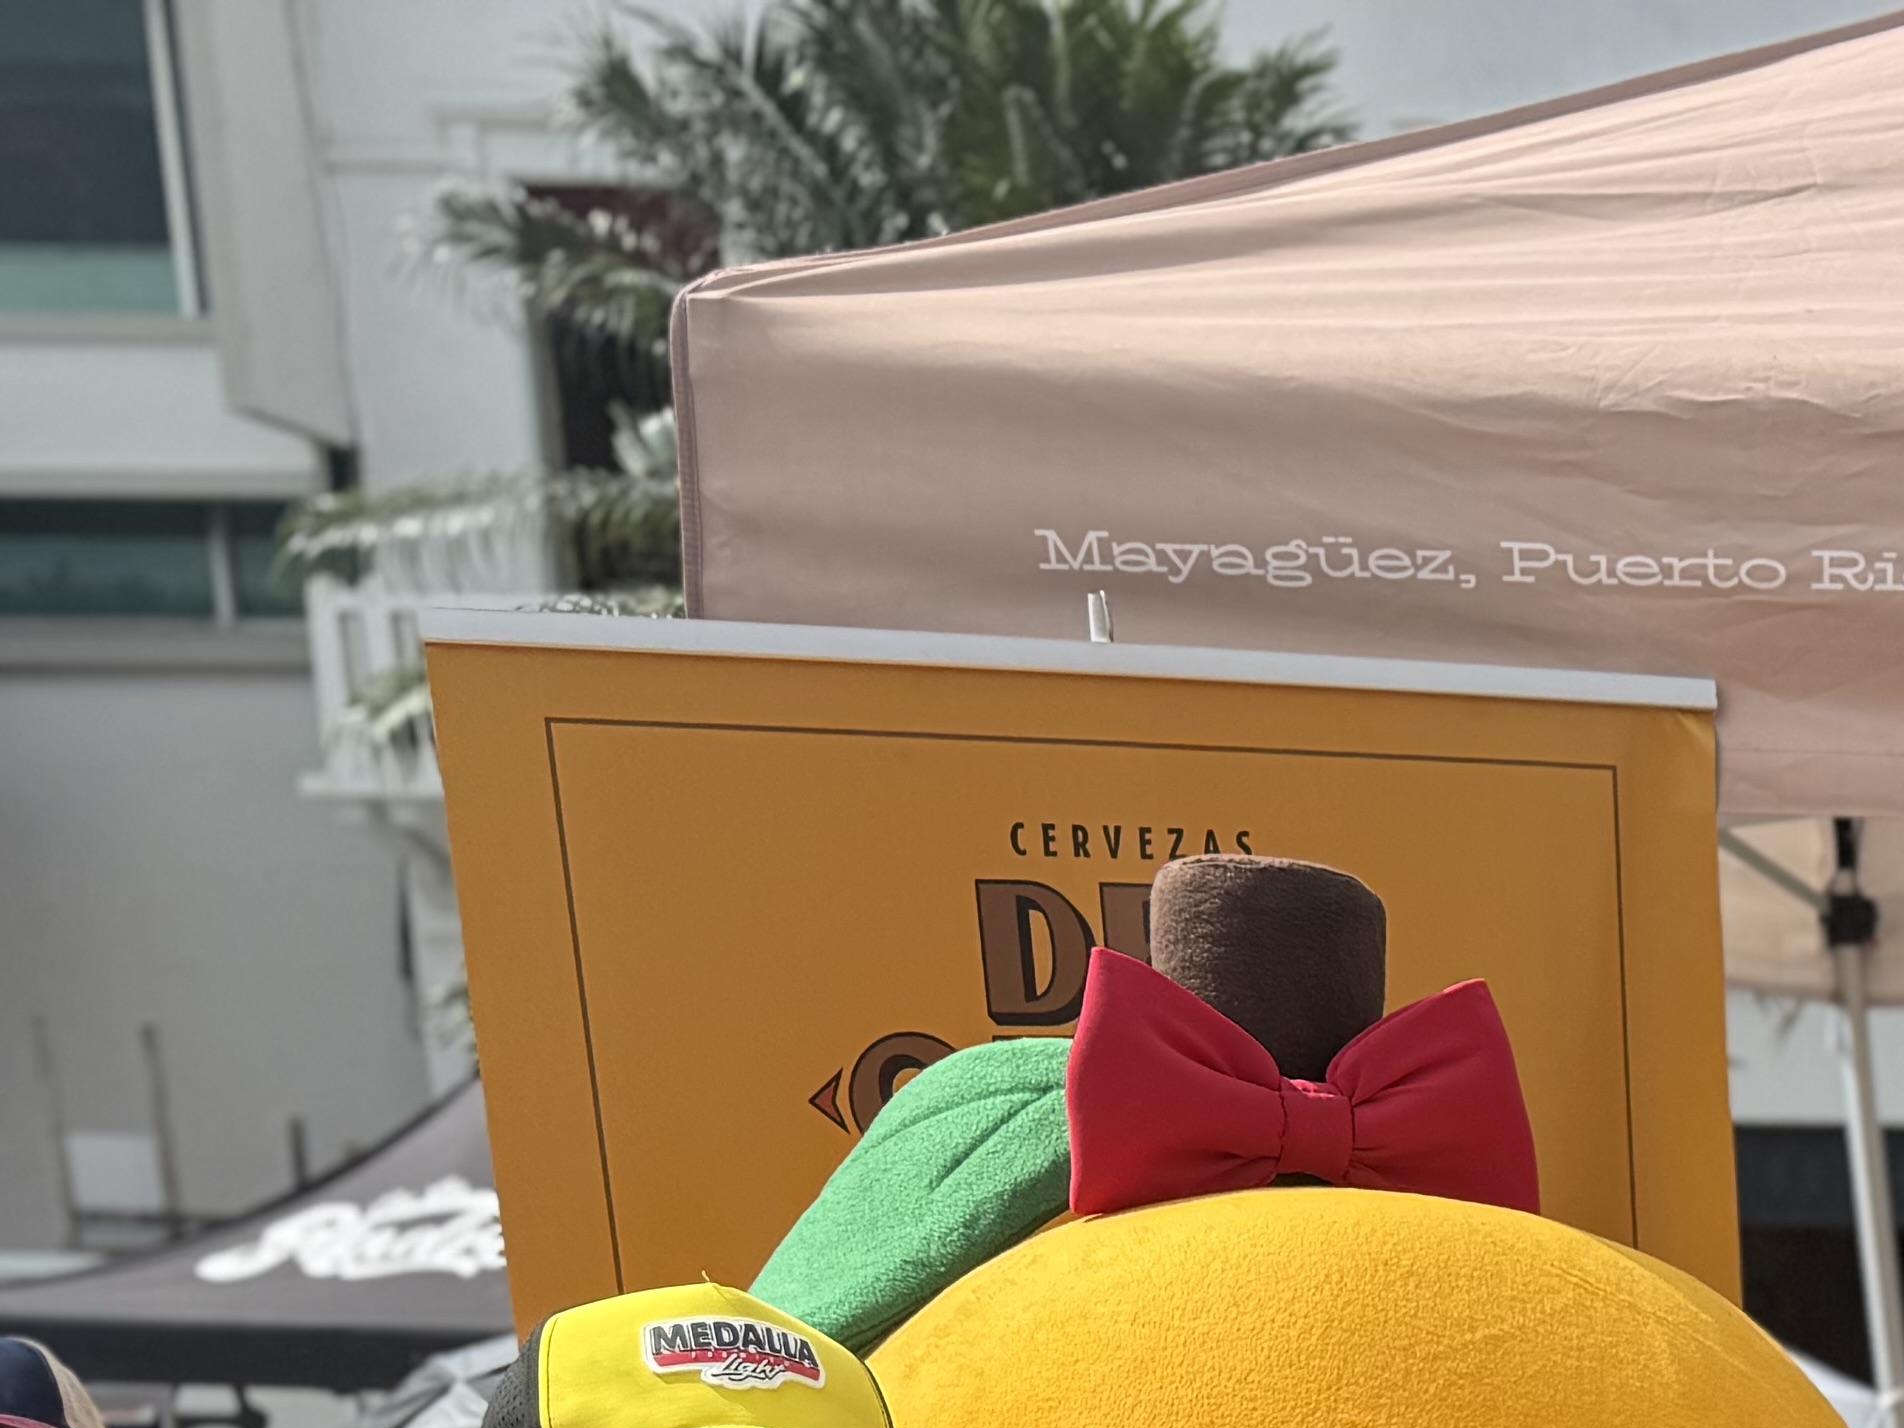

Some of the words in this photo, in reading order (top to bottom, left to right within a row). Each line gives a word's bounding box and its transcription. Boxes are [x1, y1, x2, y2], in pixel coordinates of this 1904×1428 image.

[1033, 527, 1478, 589] Mayagüez,
[1499, 540, 1787, 591] Puerto
[1008, 822, 1255, 860] CERVEZAS
[650, 1321, 820, 1370] MEDALLA
